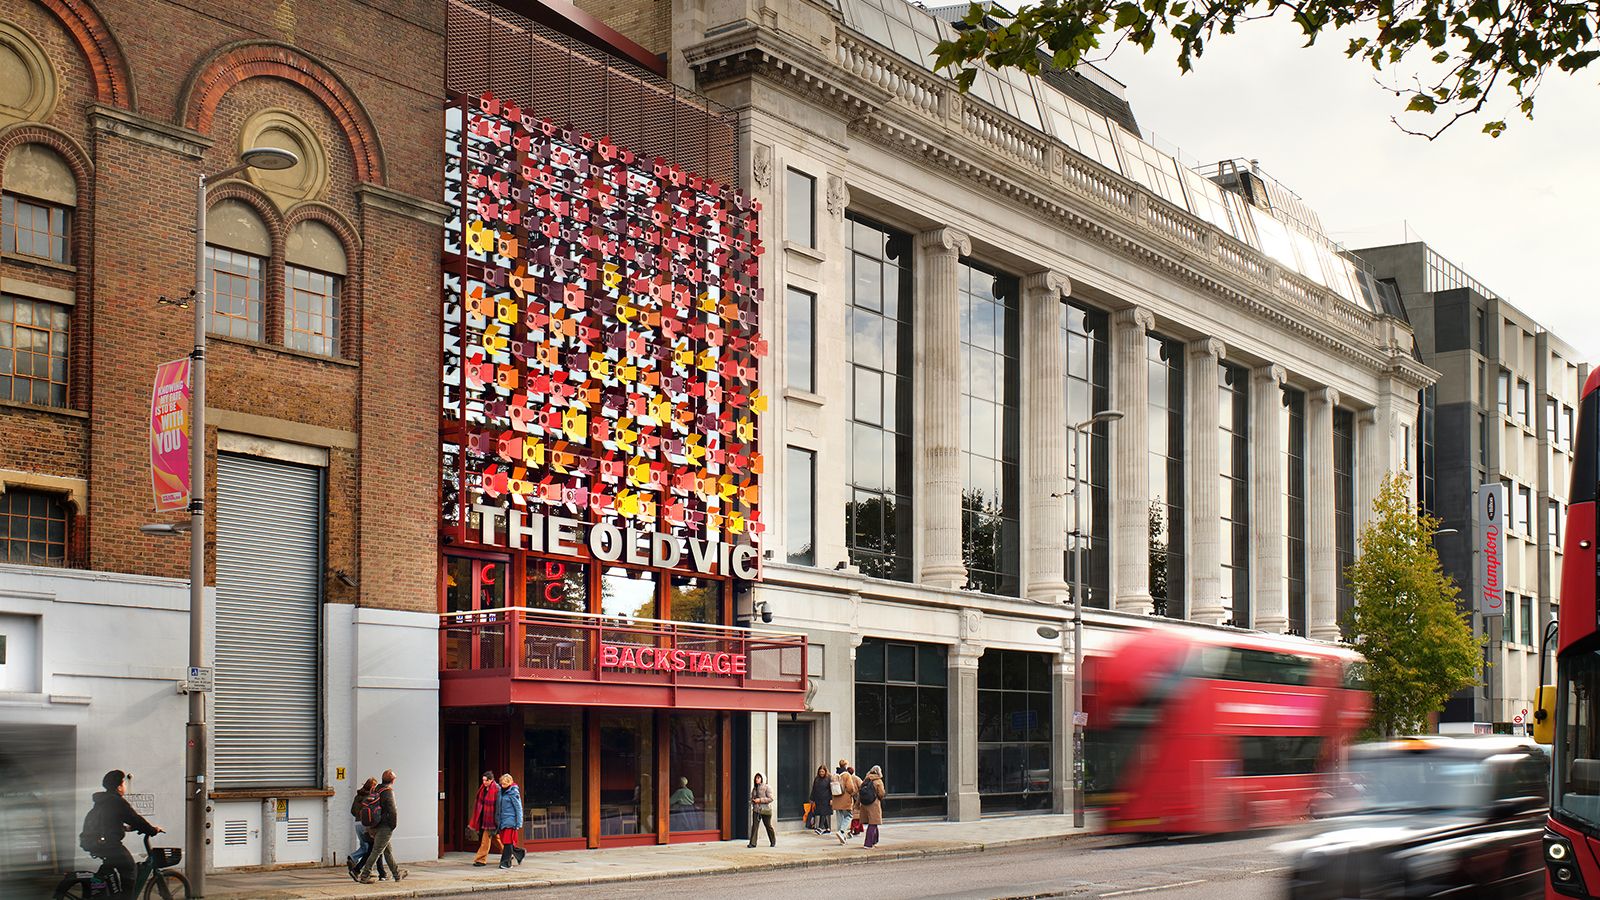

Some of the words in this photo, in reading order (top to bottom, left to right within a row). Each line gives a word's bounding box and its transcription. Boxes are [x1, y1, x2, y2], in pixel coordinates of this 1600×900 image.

[158, 381, 184, 396] KNOWING
[161, 403, 168, 414] TO
[169, 402, 177, 411] BE
[161, 409, 184, 430] WITH
[156, 429, 181, 455] YOU
[472, 504, 579, 557] THE
[589, 522, 682, 569] OLD
[688, 537, 759, 580] VIC
[1483, 524, 1502, 608] Hampton
[601, 645, 748, 675] BACKSTAGE
